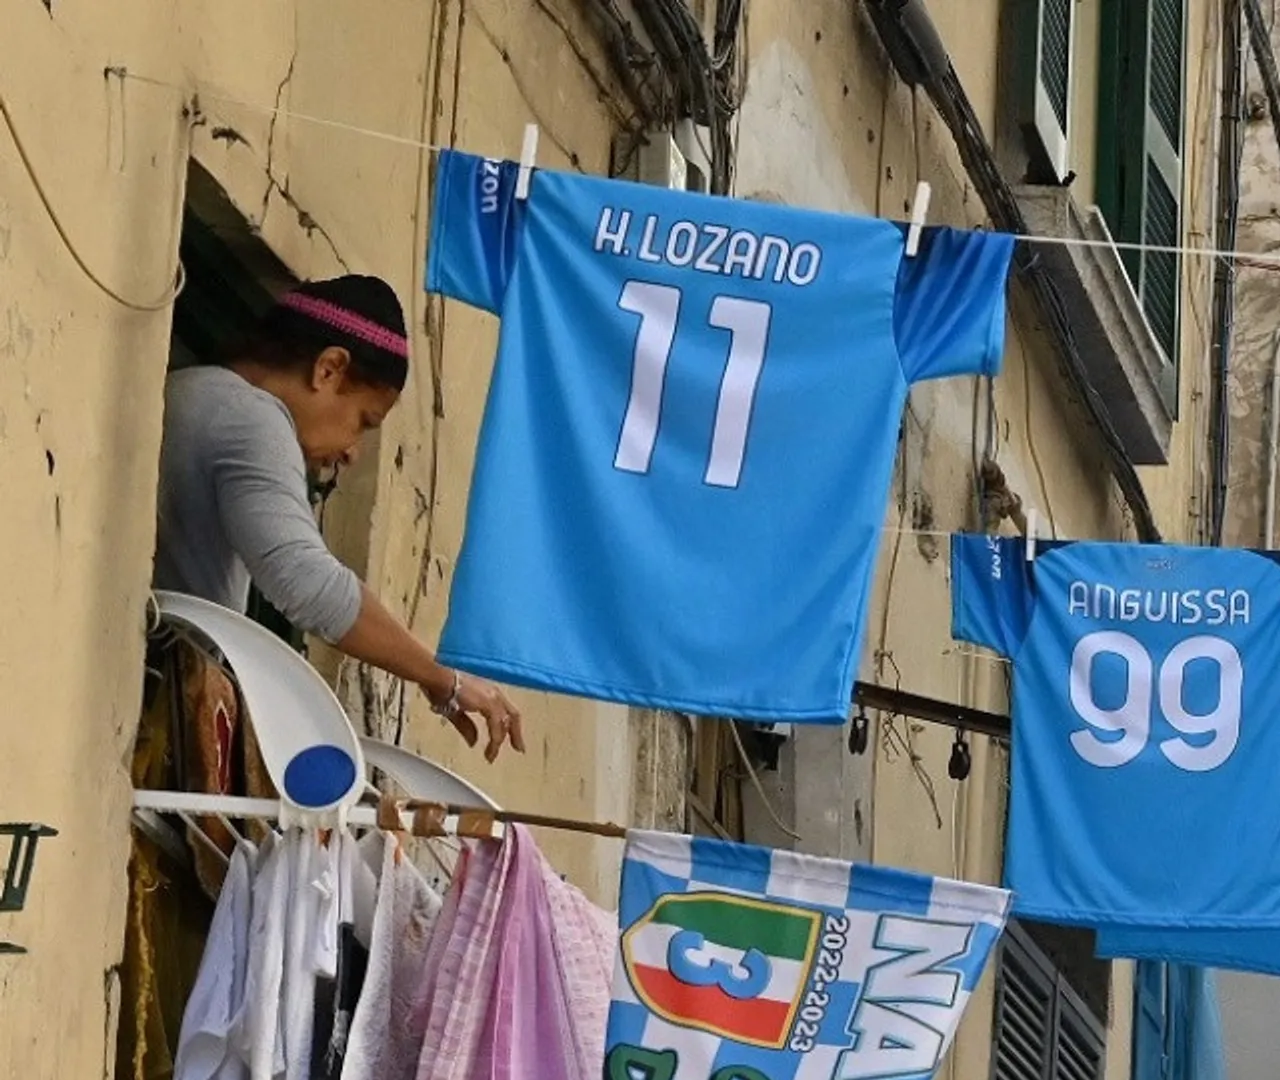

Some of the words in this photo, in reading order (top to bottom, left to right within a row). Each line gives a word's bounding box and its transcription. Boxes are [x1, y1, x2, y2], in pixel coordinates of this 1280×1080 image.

[611, 279, 772, 488] 11
[1068, 580, 1251, 626] ANGUISSA
[1068, 629, 1245, 773] 99
[667, 929, 771, 1000] 3
[789, 913, 851, 1054] 2022-2023
